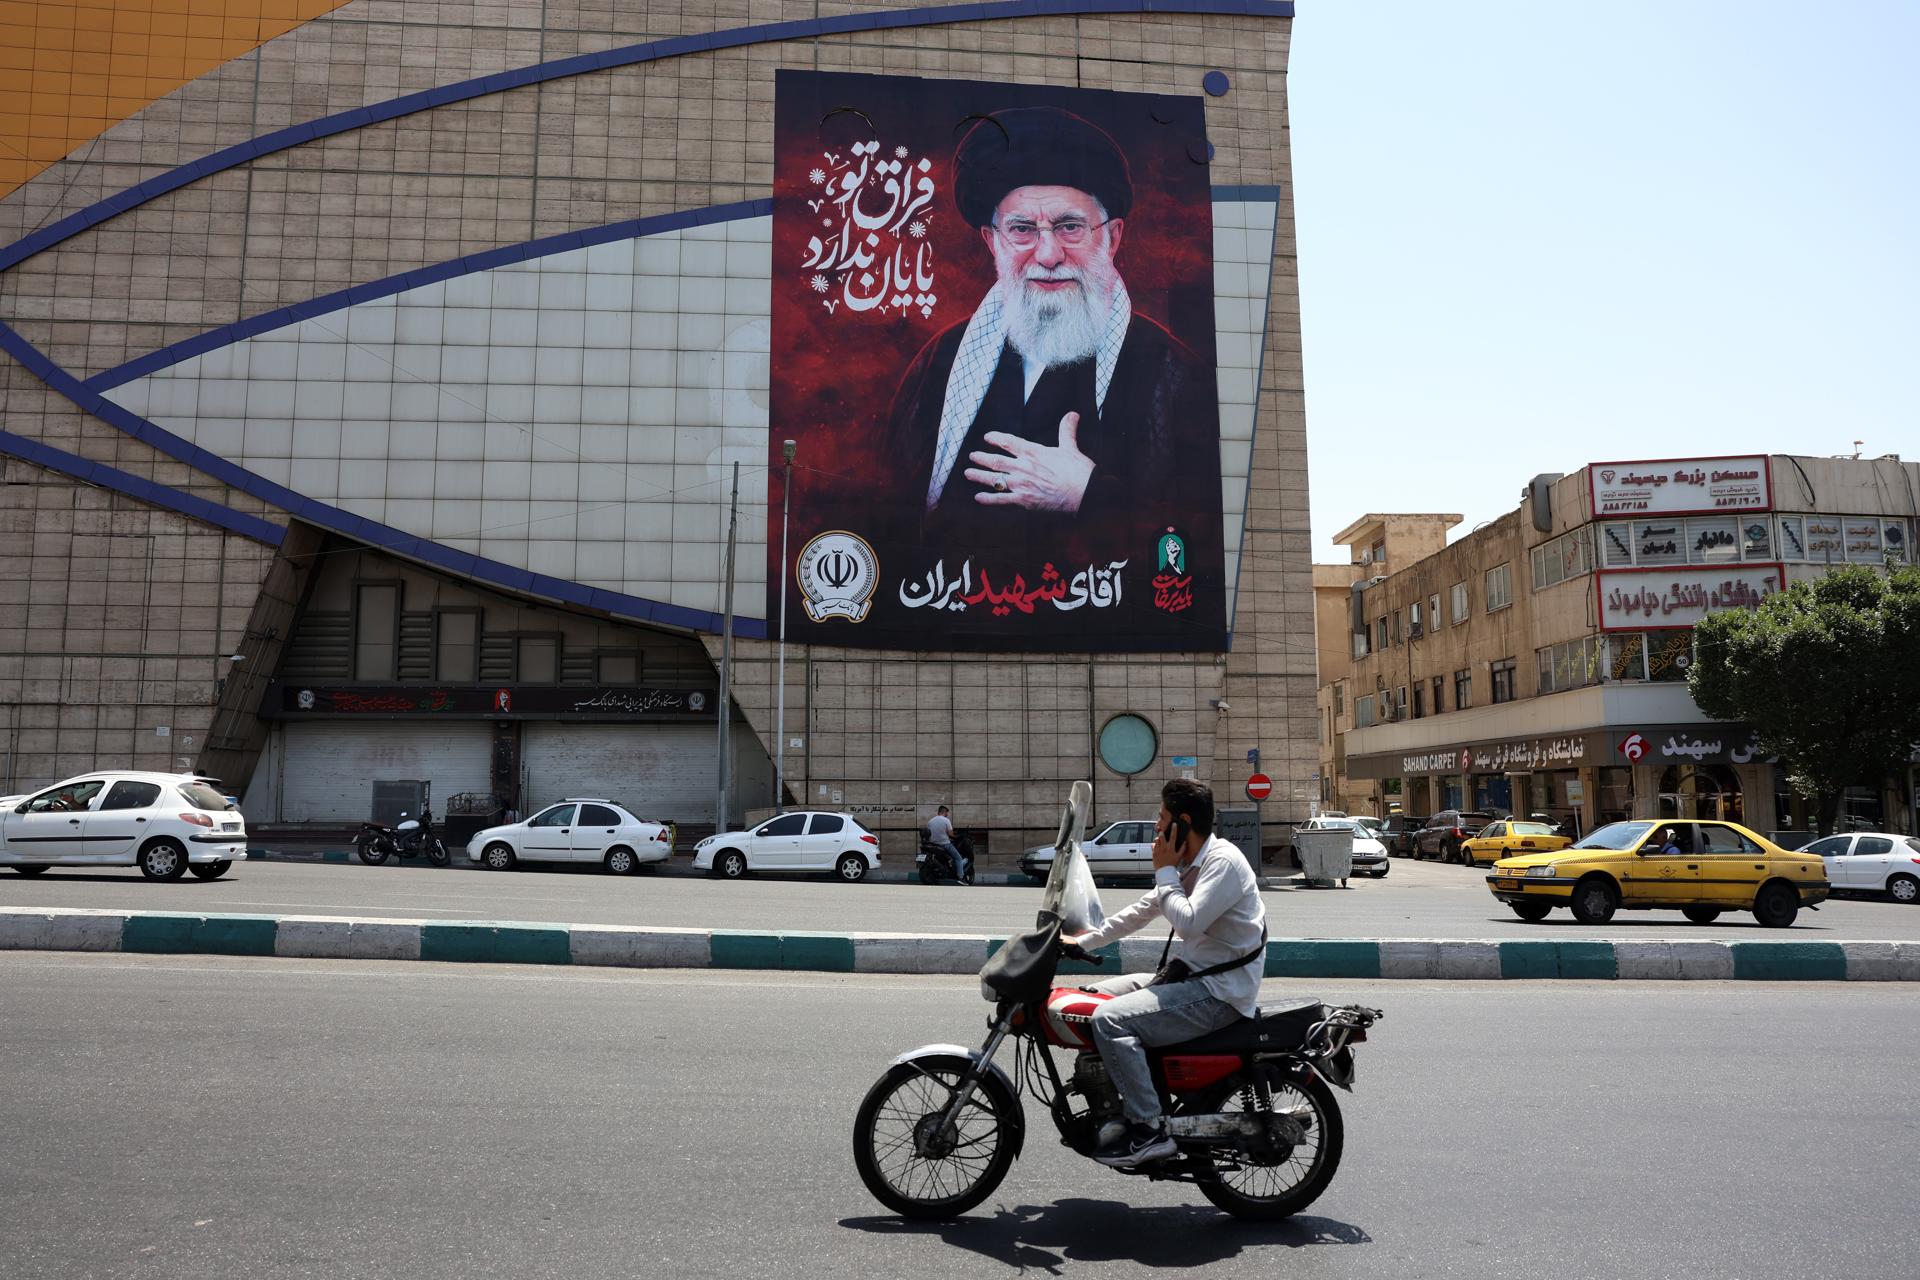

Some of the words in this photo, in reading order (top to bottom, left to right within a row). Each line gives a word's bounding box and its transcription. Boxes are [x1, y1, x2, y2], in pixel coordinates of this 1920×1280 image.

[852, 158, 935, 238] فراق
[801, 217, 880, 271] ندارد
[843, 243, 937, 316] پایان
[1673, 468, 1706, 488] بزرگ
[1711, 470, 1759, 483] مسکن
[899, 558, 971, 612] ایران
[957, 562, 1067, 616] شهید
[1052, 558, 1129, 611] آقای
[1608, 586, 1660, 618] دیاموند
[1678, 658, 1687, 666] 50
[1475, 751, 1491, 769] سهند
[1491, 744, 1509, 770] فرش
[1510, 740, 1540, 768] فروشگاه
[1541, 750, 1547, 767] و
[1548, 737, 1584, 765] نمایشگاه
[1661, 734, 1722, 760] سهند
[1403, 755, 1429, 773] SAHAND
[1429, 752, 1457, 770] CARPET
